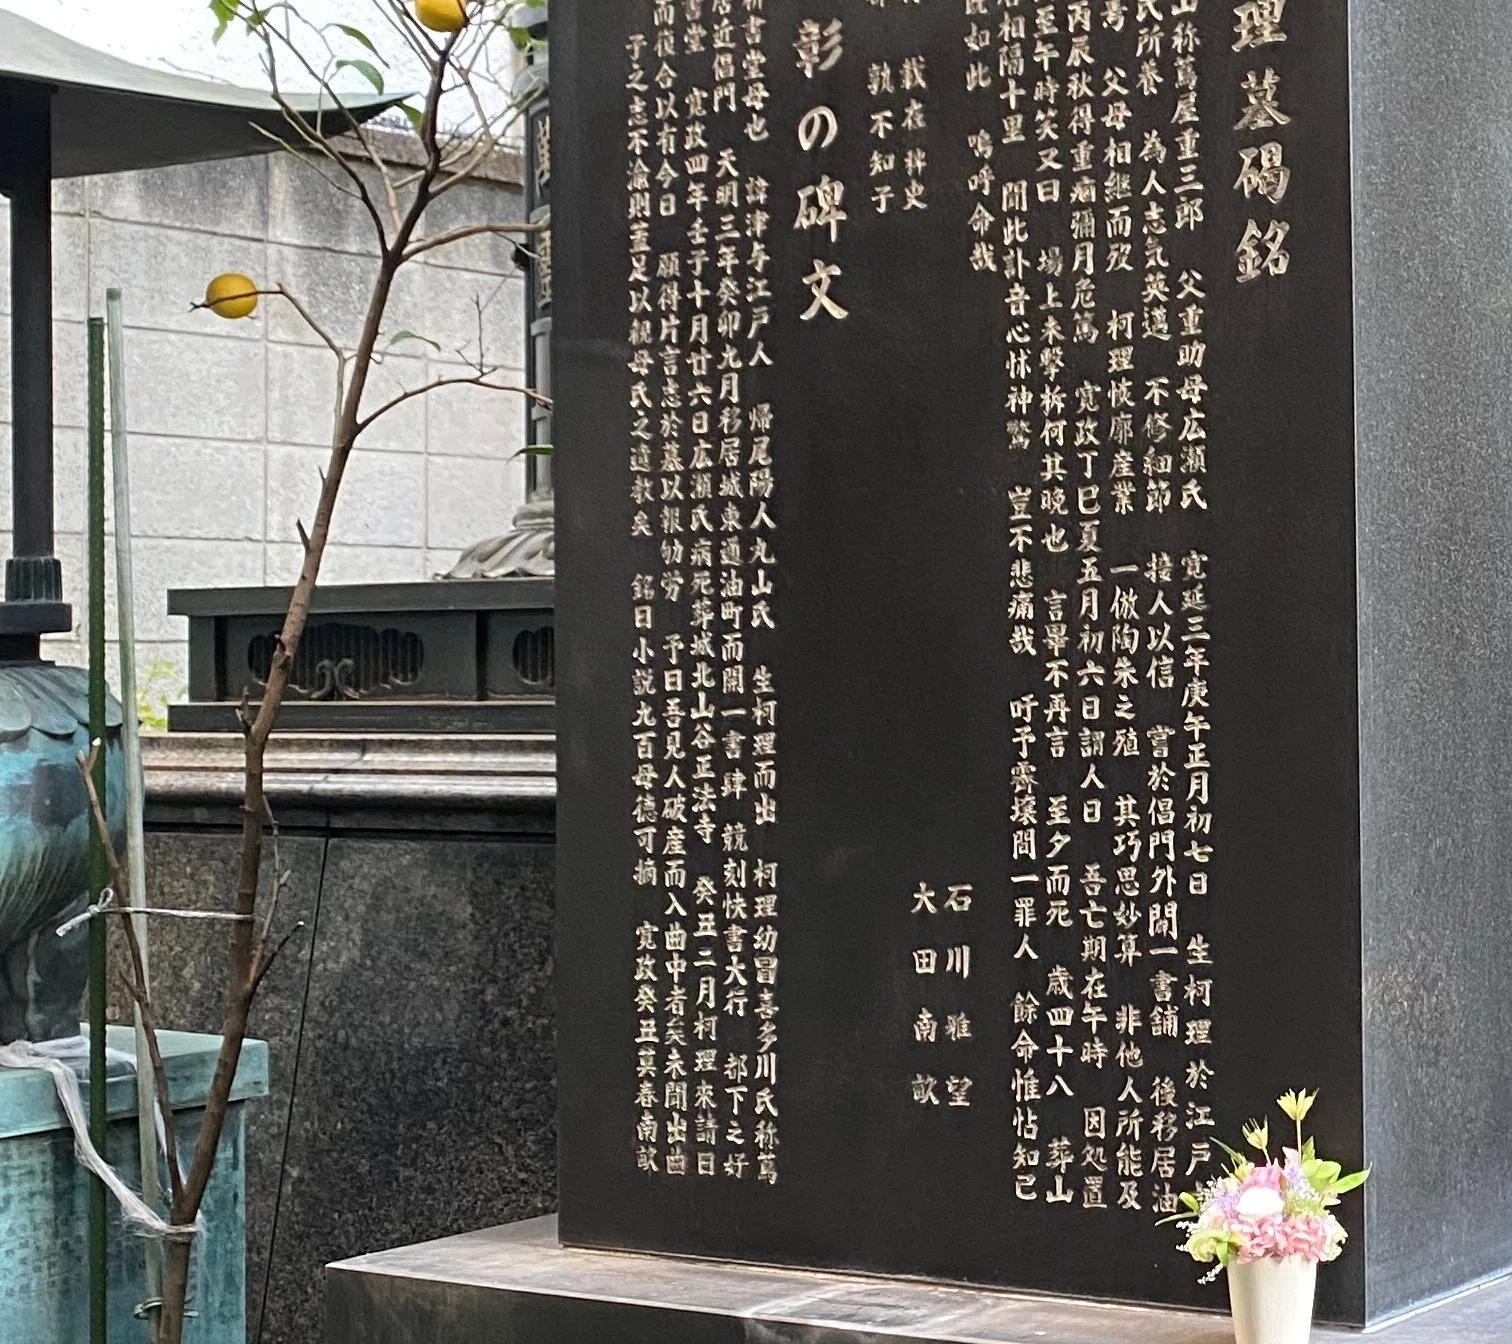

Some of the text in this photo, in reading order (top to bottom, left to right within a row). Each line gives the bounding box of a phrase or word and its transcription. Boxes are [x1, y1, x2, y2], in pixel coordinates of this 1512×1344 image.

[967, 128, 998, 273] 嗚呼命哉
[1007, 484, 1038, 657] 豈不悲痛哉
[1143, 551, 1175, 690] 接人以信
[751, 664, 779, 826] 生柯理而出
[1044, 794, 1074, 928] 至夕而死
[1112, 793, 1143, 968] 其巧思妙算
[910, 880, 941, 1106] 大田南畝
[943, 883, 974, 1107] 石川雅望
[1045, 963, 1075, 1097] 歳四十八
[1078, 861, 1109, 1070] 吾亡期在午時
[723, 1052, 750, 1179] 都下之好
[1114, 1002, 1145, 1211] 非他人所能及
[1149, 1075, 1180, 1214] 後移居油
[1184, 932, 1216, 1205] 生柯理於江戸
[1045, 1135, 1075, 1204] 葬山
[1080, 1106, 1109, 1209] 因処置
